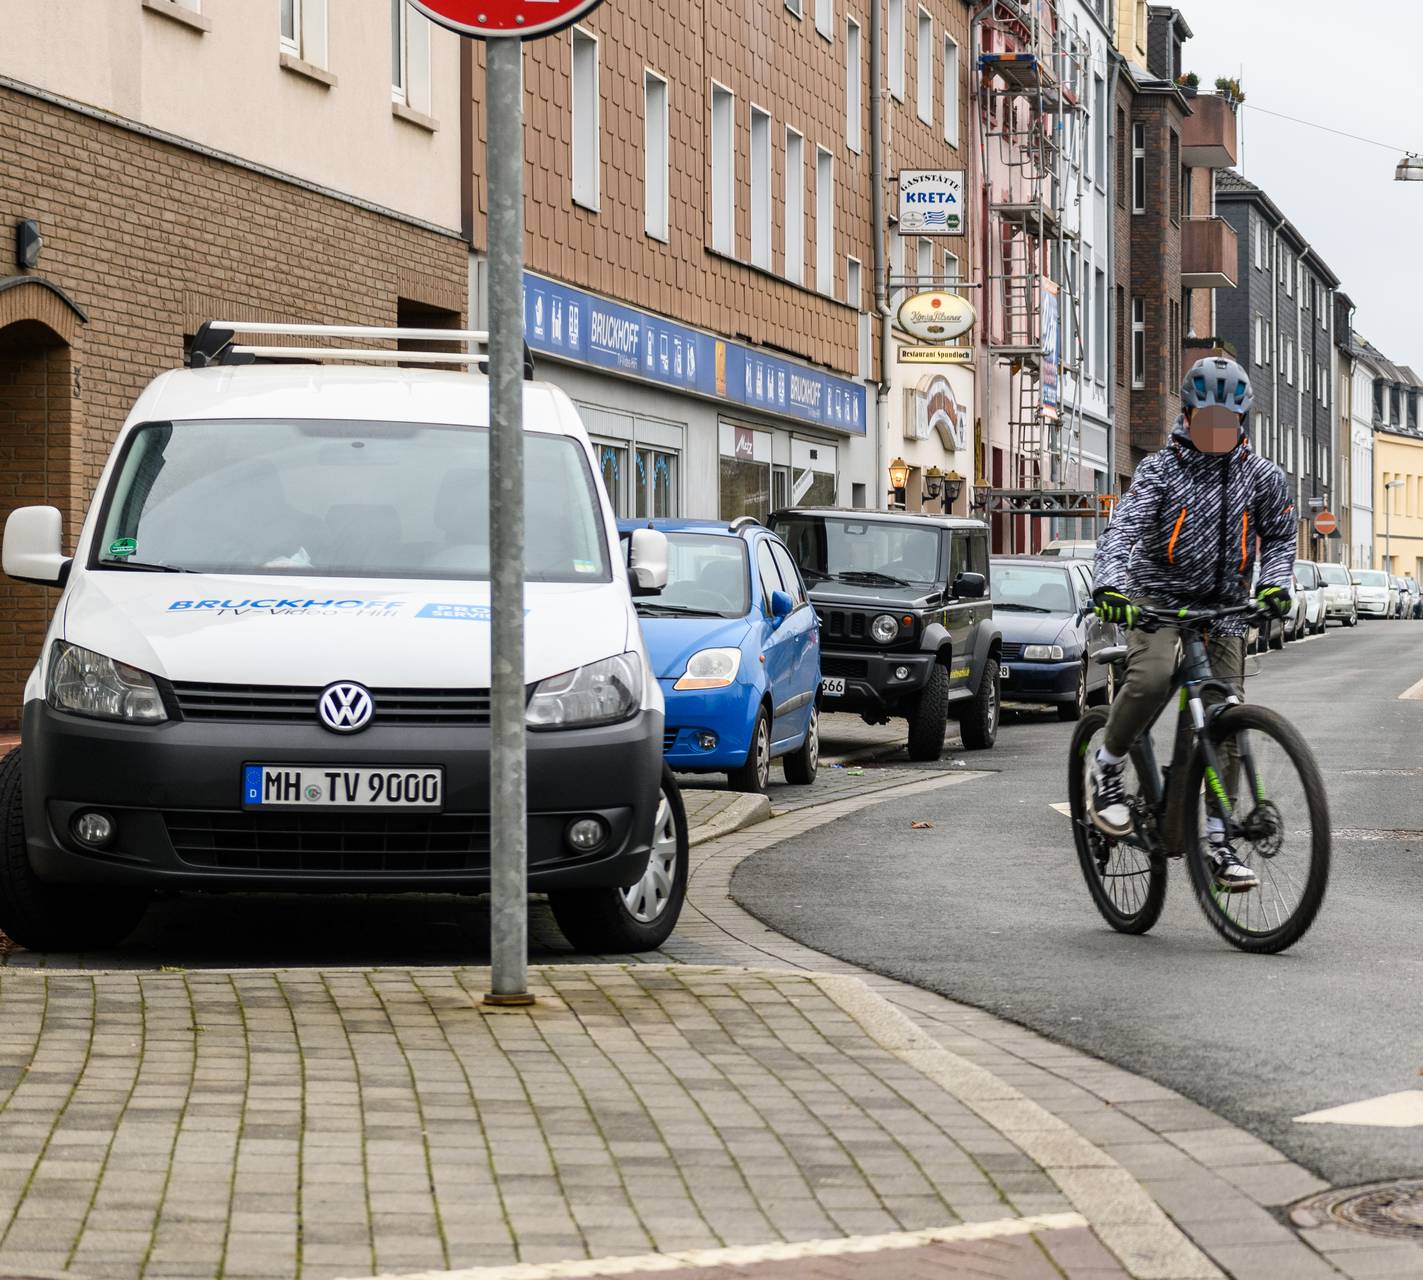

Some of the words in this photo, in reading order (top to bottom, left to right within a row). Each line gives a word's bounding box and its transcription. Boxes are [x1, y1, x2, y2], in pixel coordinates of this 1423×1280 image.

[905, 192, 956, 203] KRETA
[591, 311, 639, 354] BRUCKHOFF
[902, 350, 936, 358] Restaurant
[937, 351, 969, 359] Spundloch
[790, 374, 821, 407] BRUCKHOFF
[168, 600, 406, 609] BRUCKHOFF
[431, 611, 490, 620] SERVI
[250, 789, 257, 798] D
[265, 772, 301, 801] MH
[325, 773, 360, 802] TV
[368, 773, 438, 803] 9000
